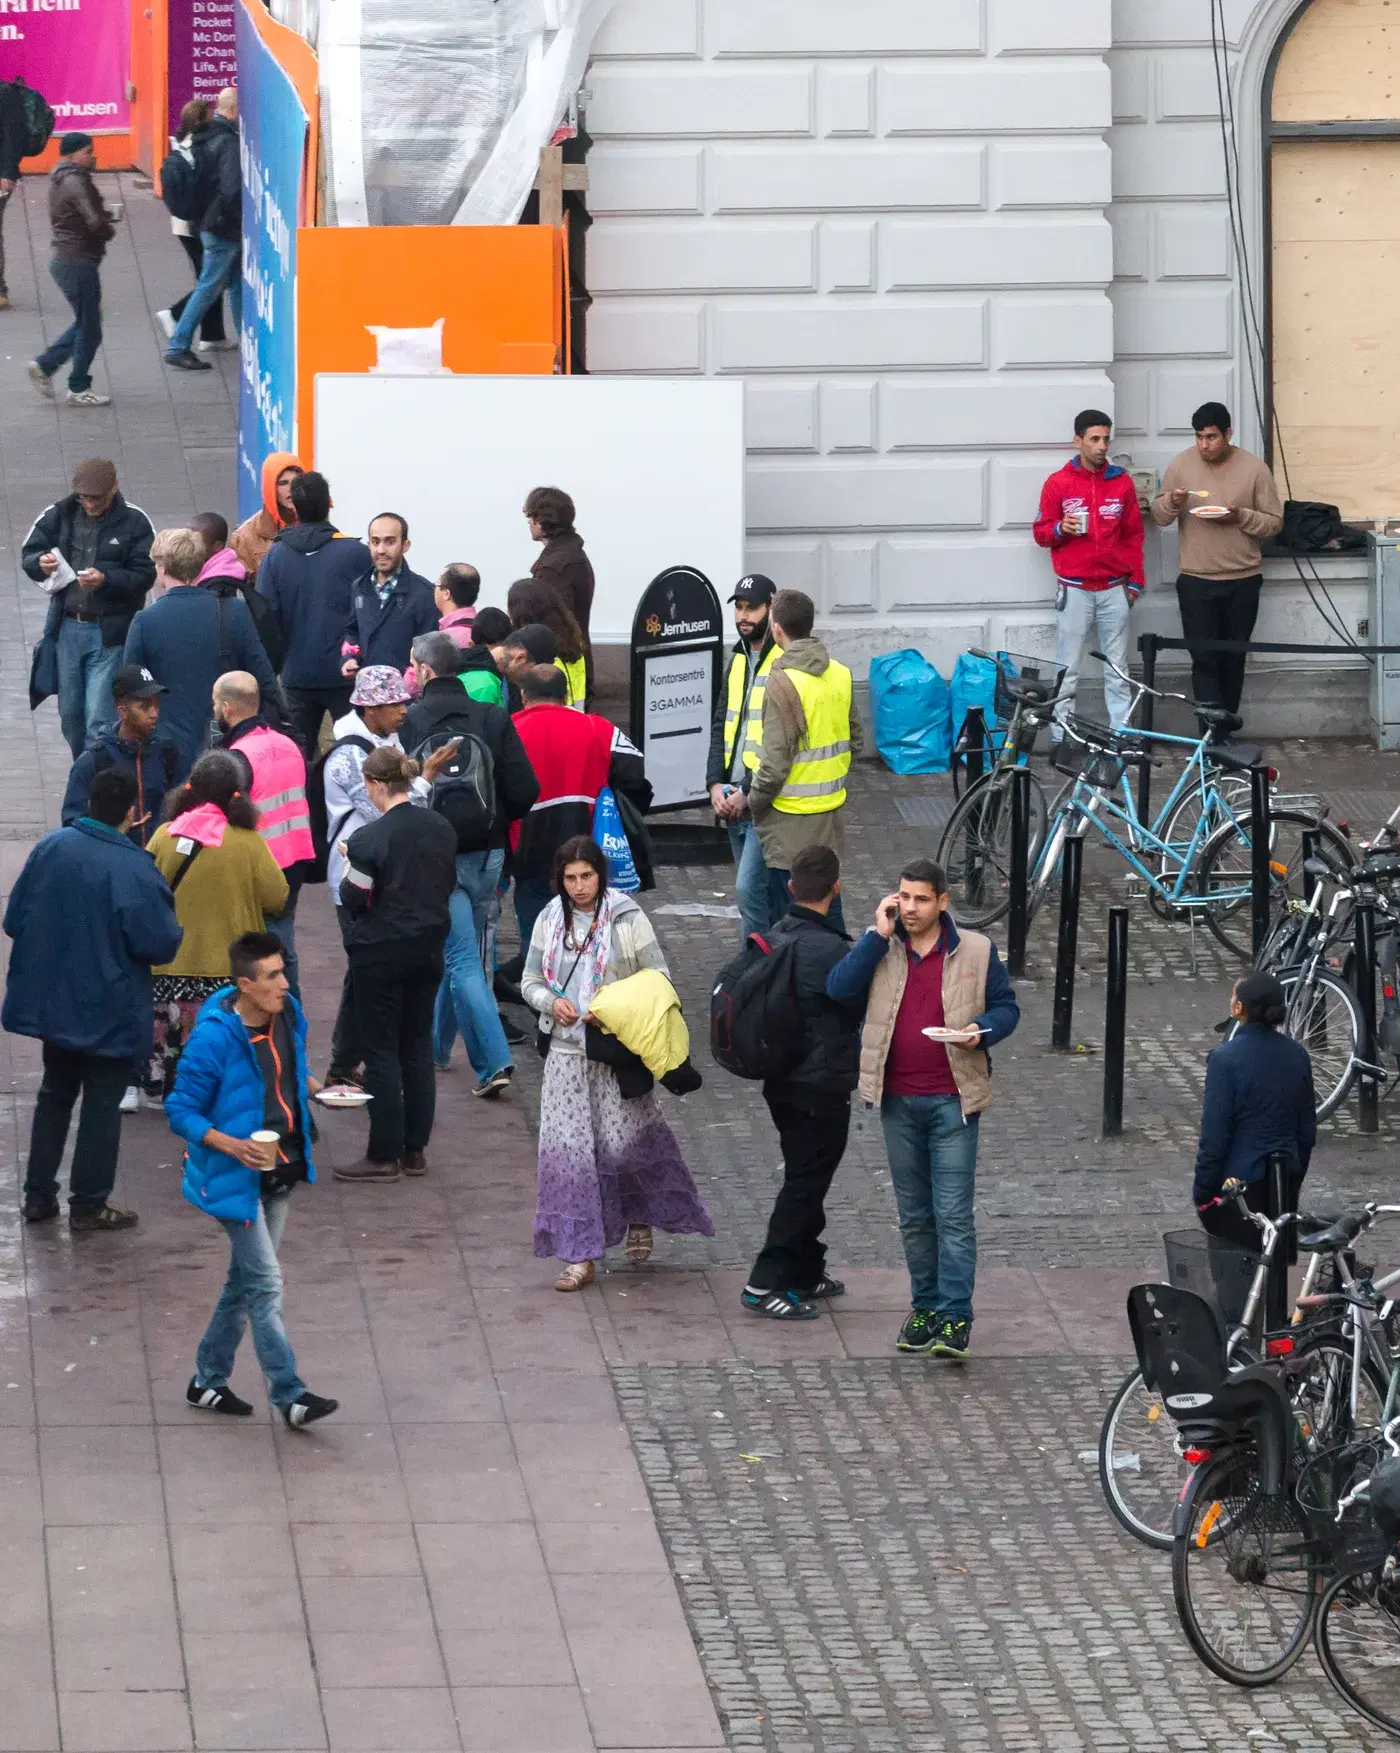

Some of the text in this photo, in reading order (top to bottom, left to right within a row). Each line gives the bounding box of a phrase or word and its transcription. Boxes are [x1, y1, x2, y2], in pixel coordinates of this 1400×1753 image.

[193, 17, 232, 27] Pocket
[193, 32, 211, 42] Mc
[193, 62, 218, 73] Life,
[193, 76, 229, 87] Beirut
[660, 619, 710, 636] Jernhusen
[650, 667, 705, 686] Kontorsentré
[650, 694, 704, 712] 3GAMMA
